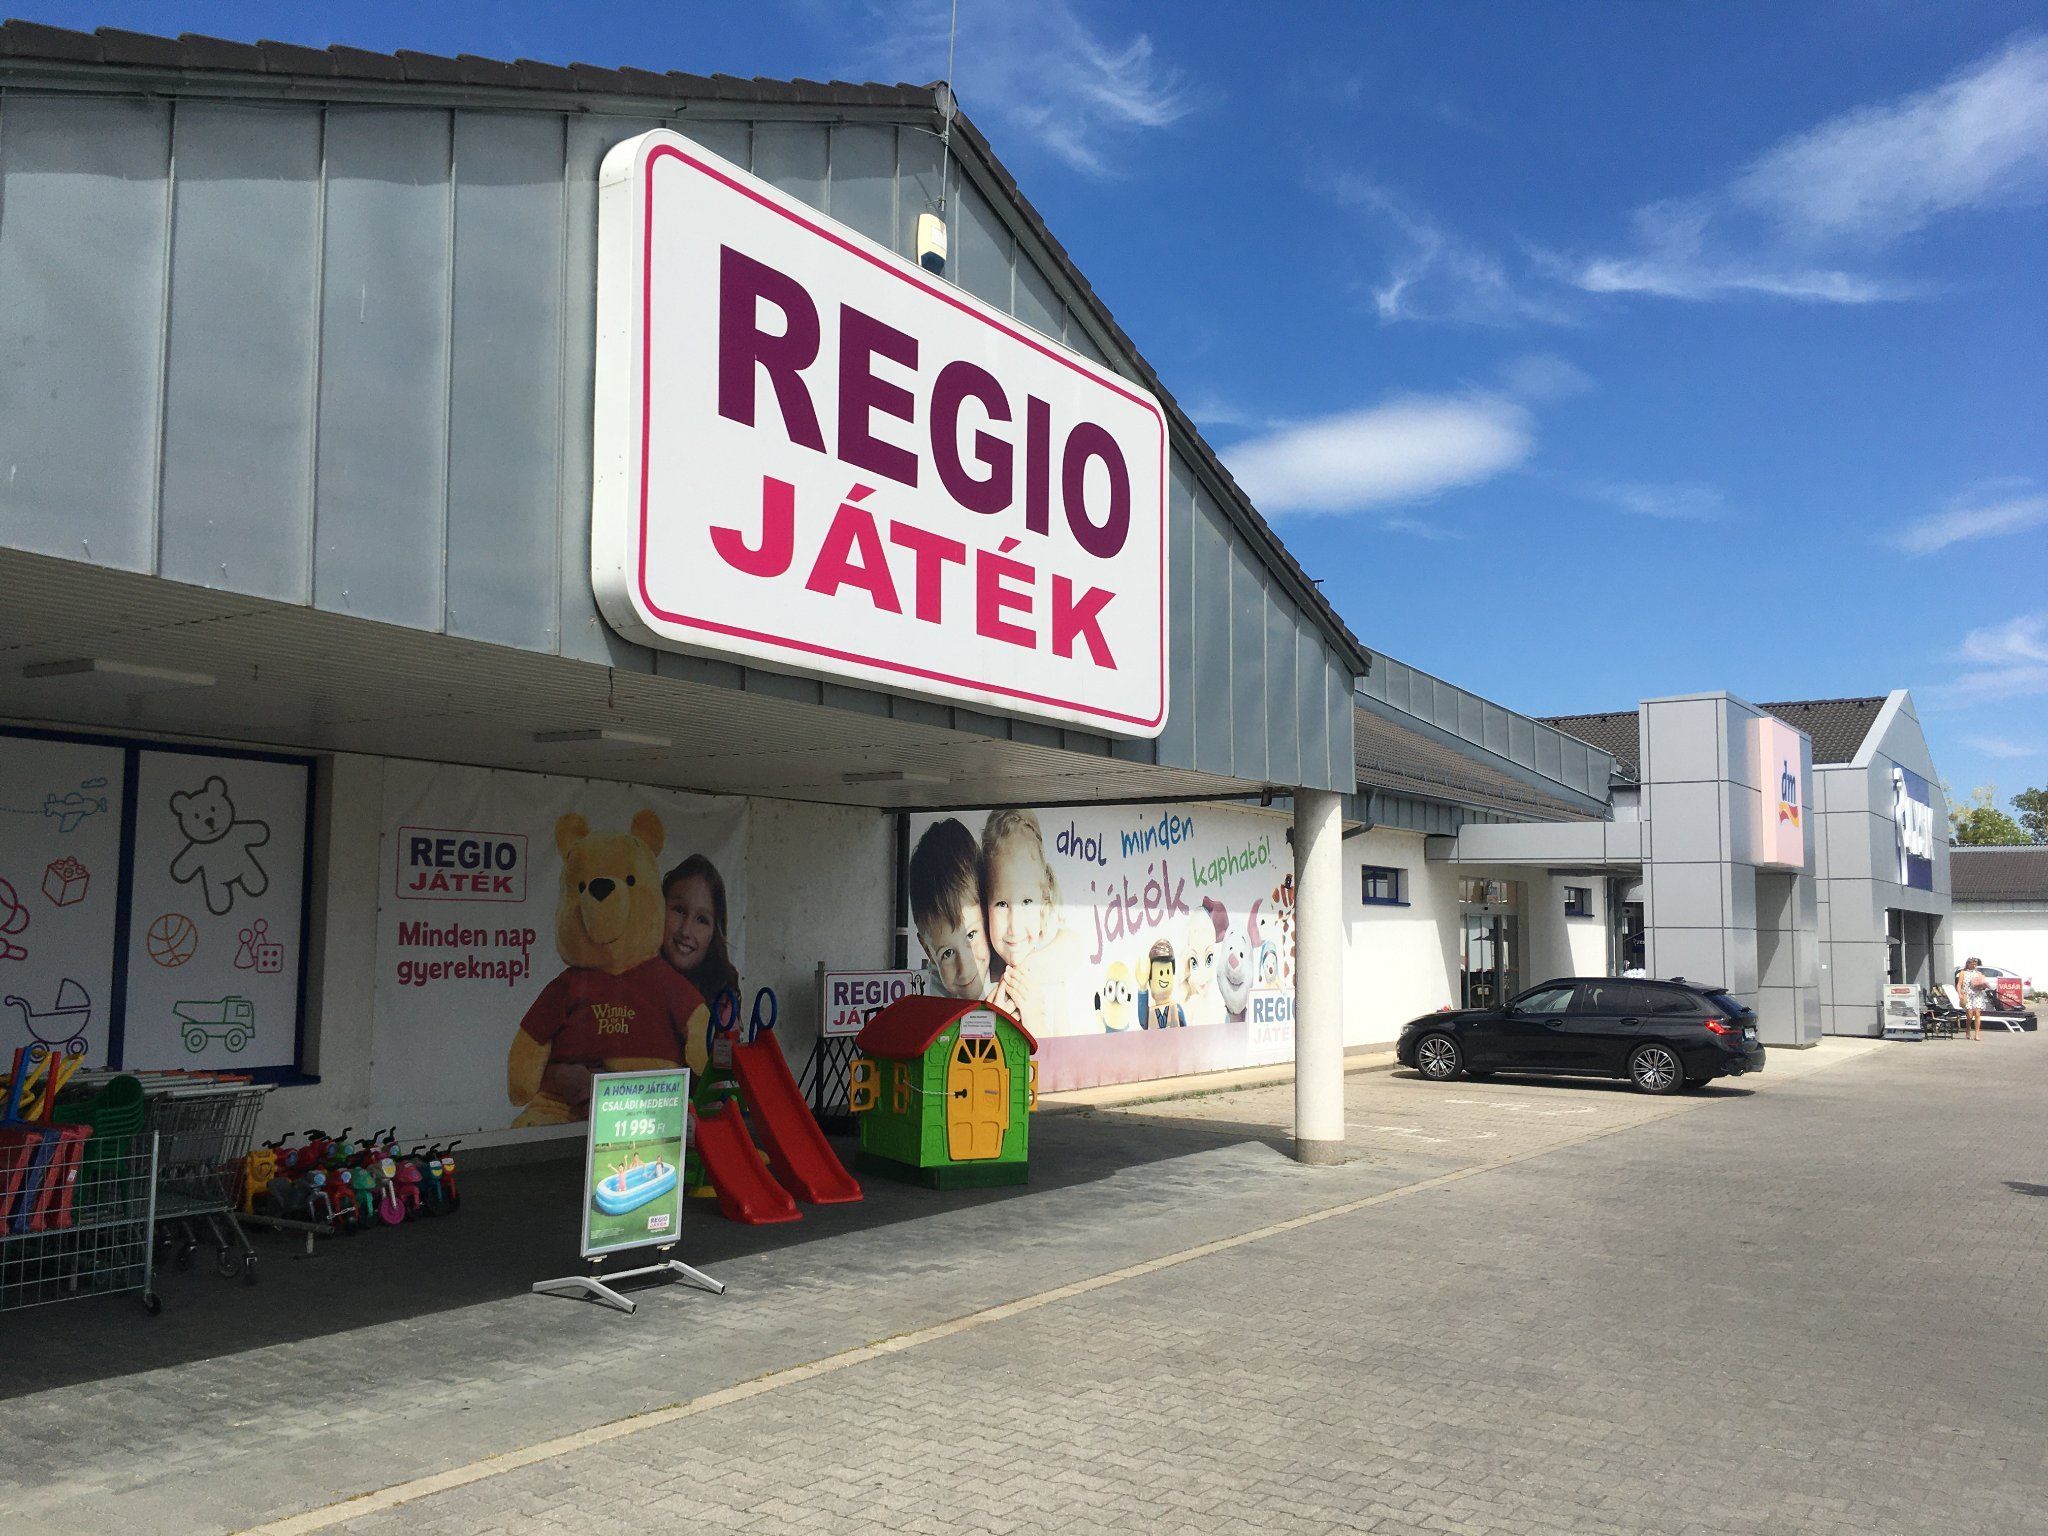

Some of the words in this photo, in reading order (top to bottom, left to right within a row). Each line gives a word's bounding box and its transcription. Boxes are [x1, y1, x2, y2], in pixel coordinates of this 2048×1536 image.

[718, 243, 1131, 559] REGIO
[709, 474, 1118, 671] JÁTÉK
[1781, 760, 1797, 804] dm
[410, 837, 517, 870] REGIO
[1056, 820, 1107, 867] ahol
[1120, 810, 1195, 858] minden
[409, 869, 513, 893] JÁTÉK
[1089, 859, 1190, 965] játék
[1191, 835, 1272, 887] kapható!
[397, 921, 488, 948] Minden
[494, 927, 537, 955] nap
[396, 953, 530, 987] gyereknap!
[833, 980, 906, 1006] REGIO
[1253, 996, 1296, 1023] REGI
[591, 1003, 636, 1019] Winnie
[597, 1018, 629, 1035] Pooh
[602, 1098, 638, 1112] CSALÁDI
[639, 1096, 680, 1110] MEDENCE
[603, 1086, 610, 1096] A
[612, 1082, 645, 1096] HÓNAP
